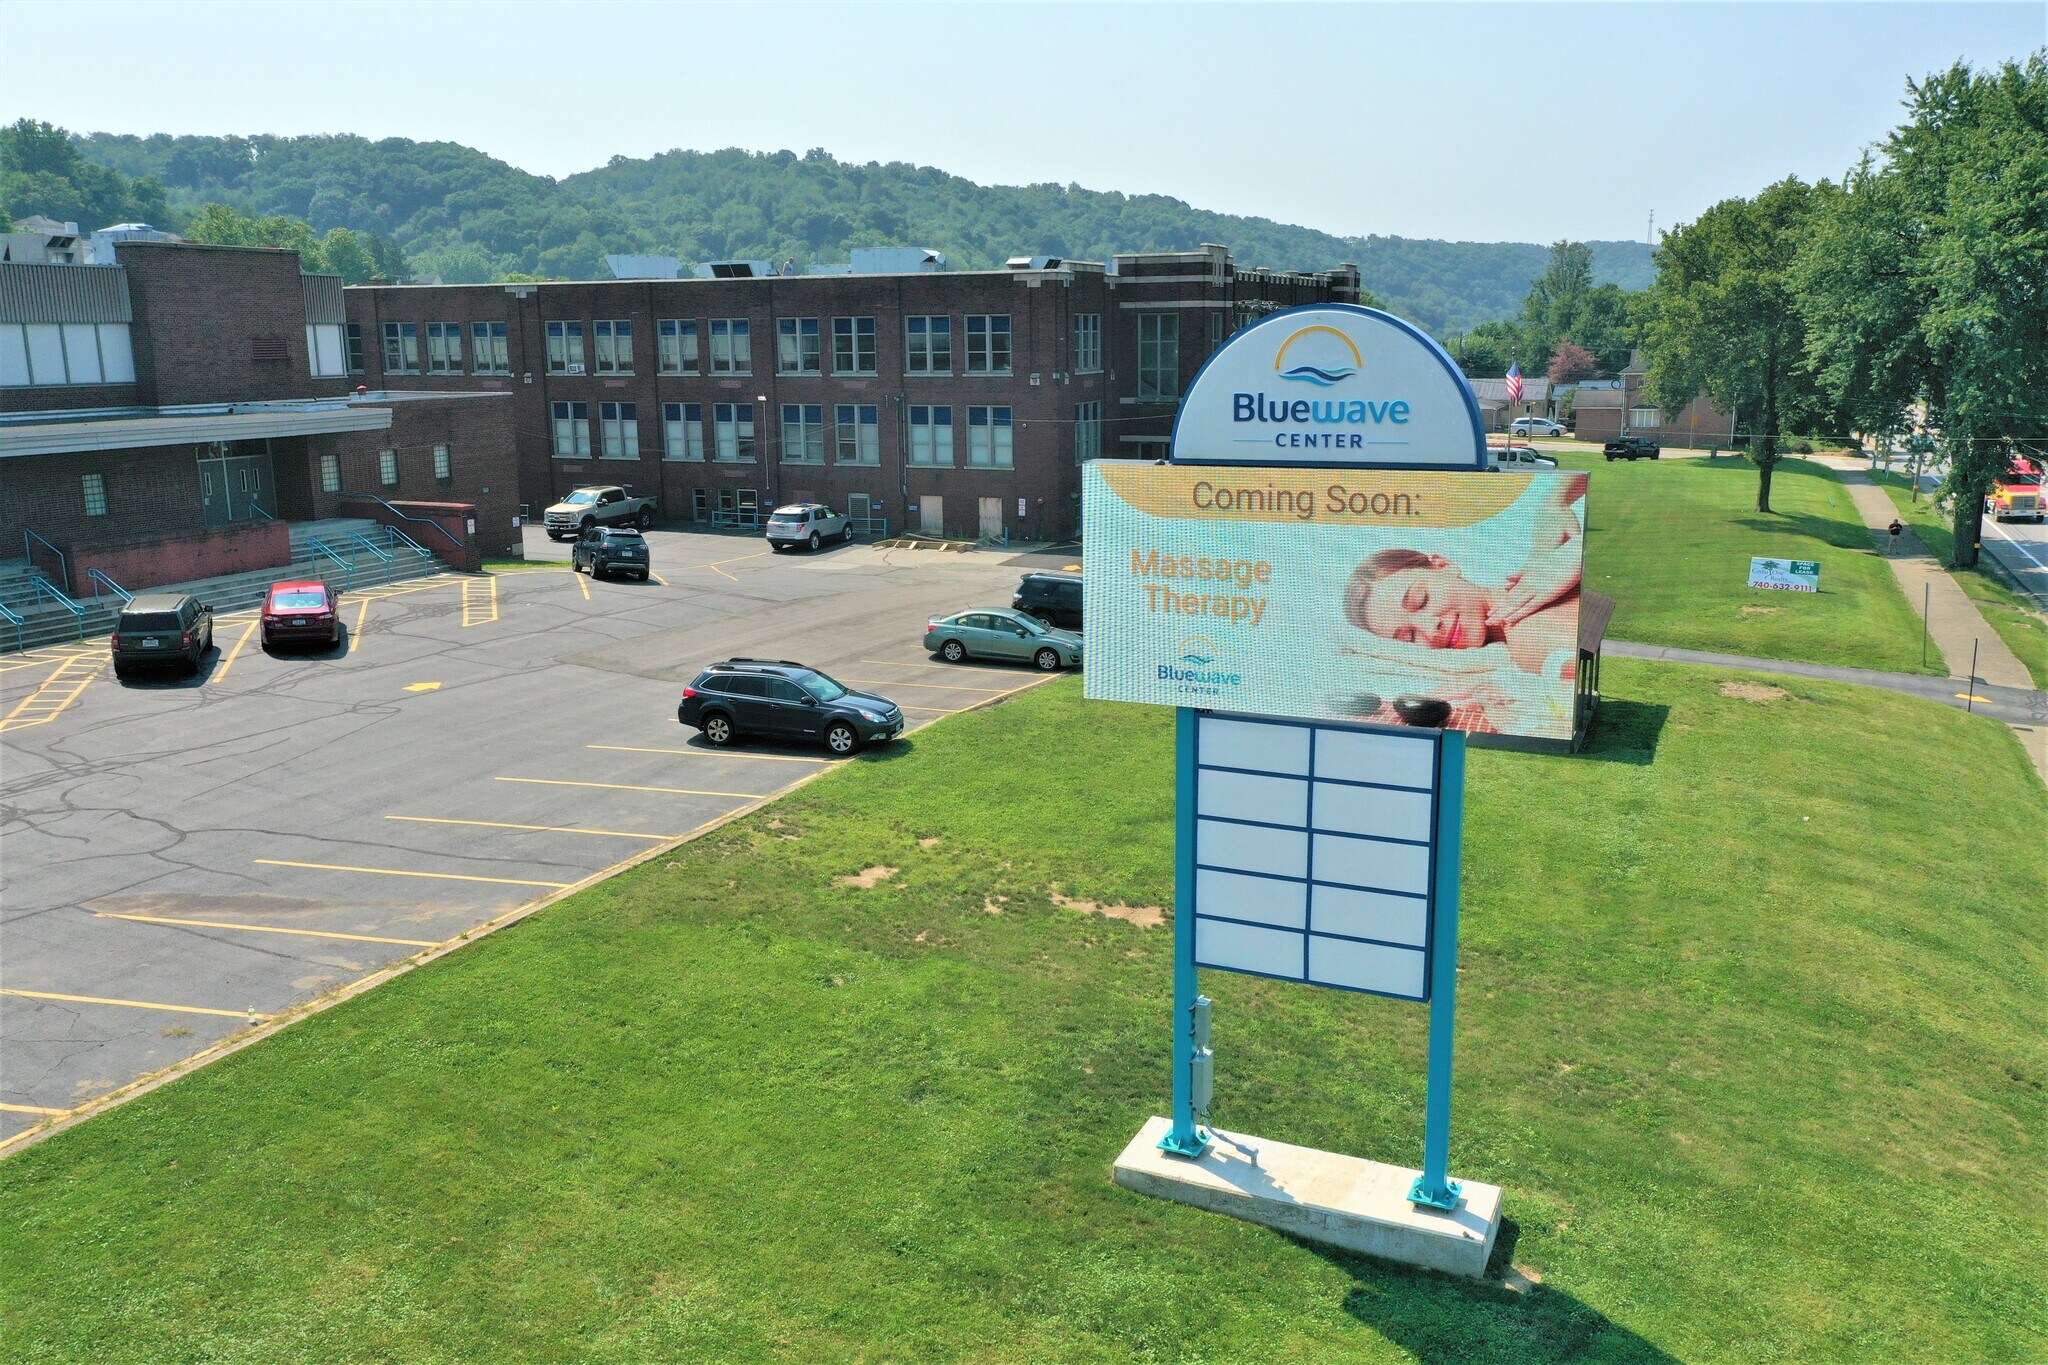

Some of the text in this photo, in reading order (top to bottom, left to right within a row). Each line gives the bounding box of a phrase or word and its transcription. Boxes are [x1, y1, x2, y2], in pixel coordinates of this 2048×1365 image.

[1233, 393, 1410, 424] Bluewave
[1275, 433, 1363, 448] CENTER
[1193, 481, 1421, 520] Coming Soon:
[1131, 549, 1272, 588] Massage
[1753, 581, 1812, 592] 740-632-9111
[1142, 584, 1267, 625] Therapy
[1158, 665, 1241, 685] Bluewave
[1178, 685, 1219, 696] CENTER
